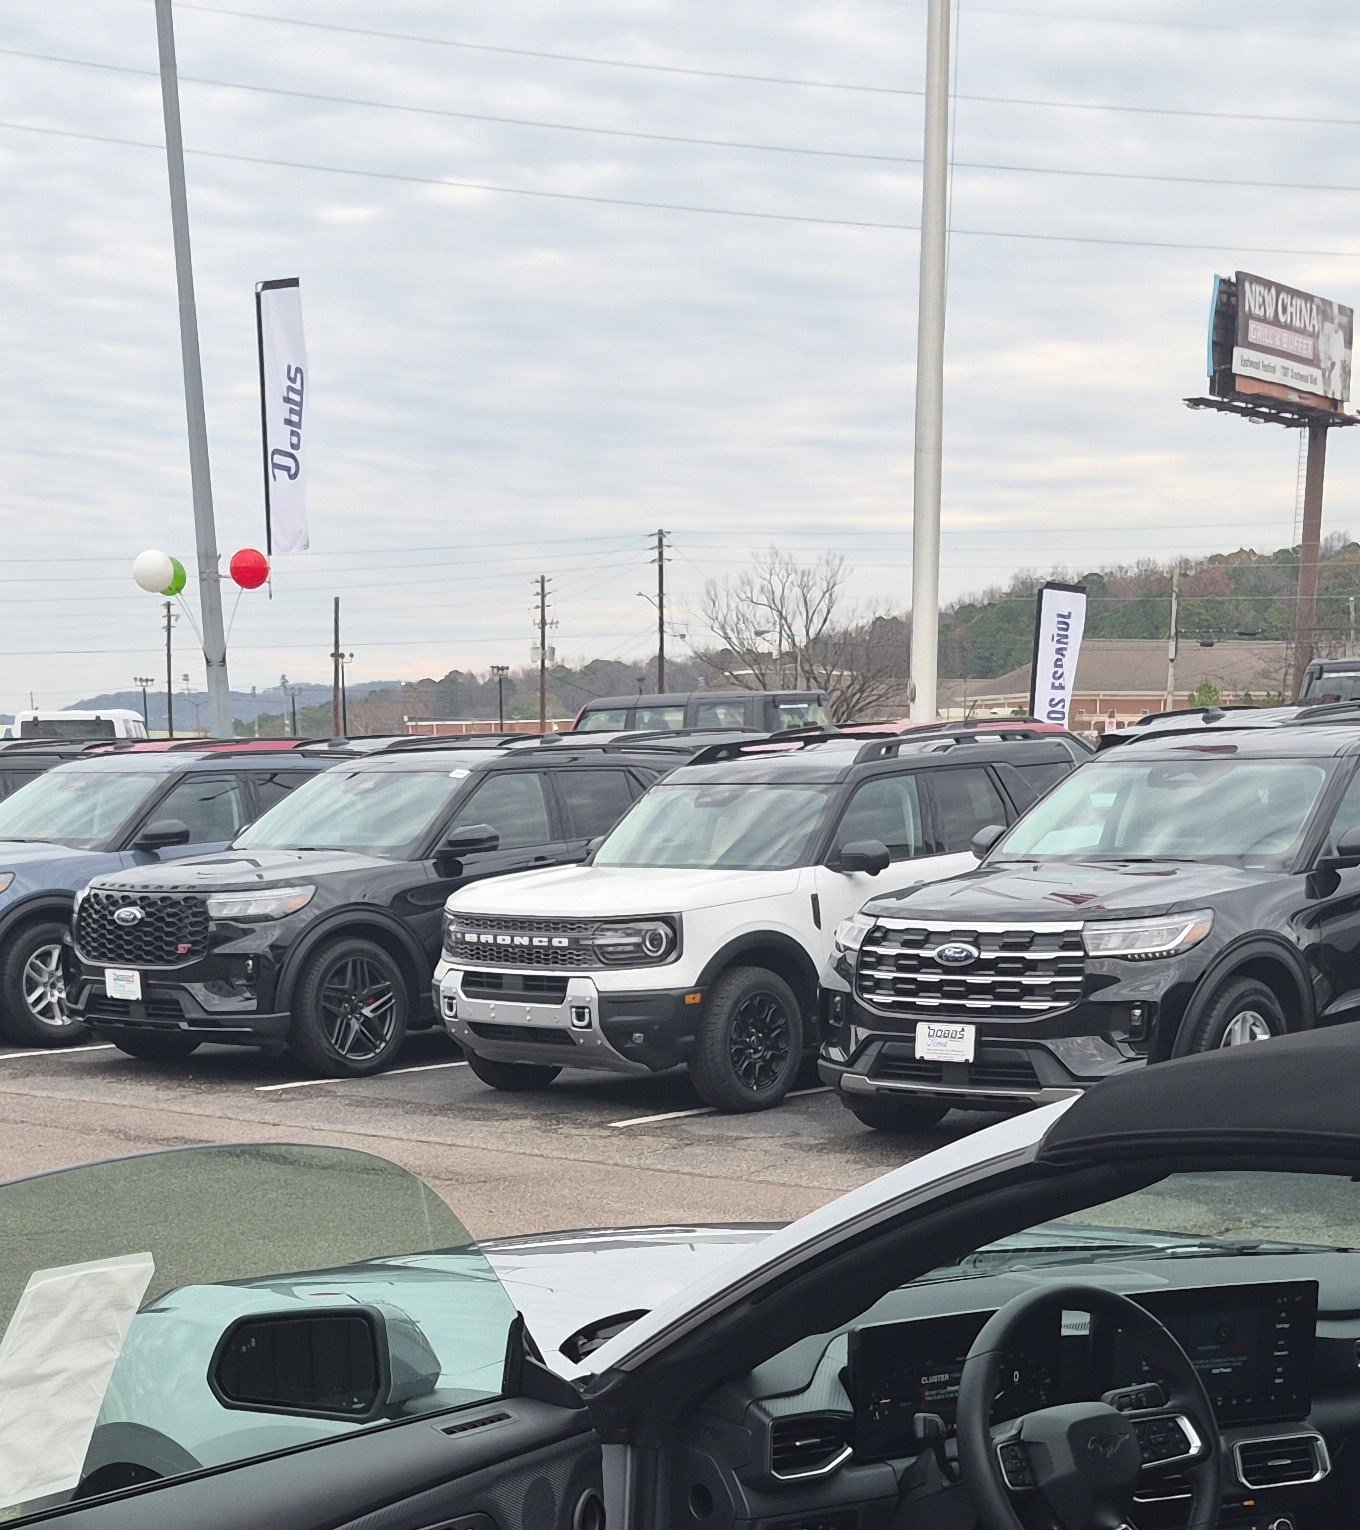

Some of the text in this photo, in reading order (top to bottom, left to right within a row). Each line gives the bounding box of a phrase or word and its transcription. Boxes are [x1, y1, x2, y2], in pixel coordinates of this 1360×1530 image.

[1244, 280, 1319, 333] NEW CHINA
[271, 364, 304, 482] Dobbs
[177, 943, 192, 954] ST
[464, 933, 569, 946] BRONCO
